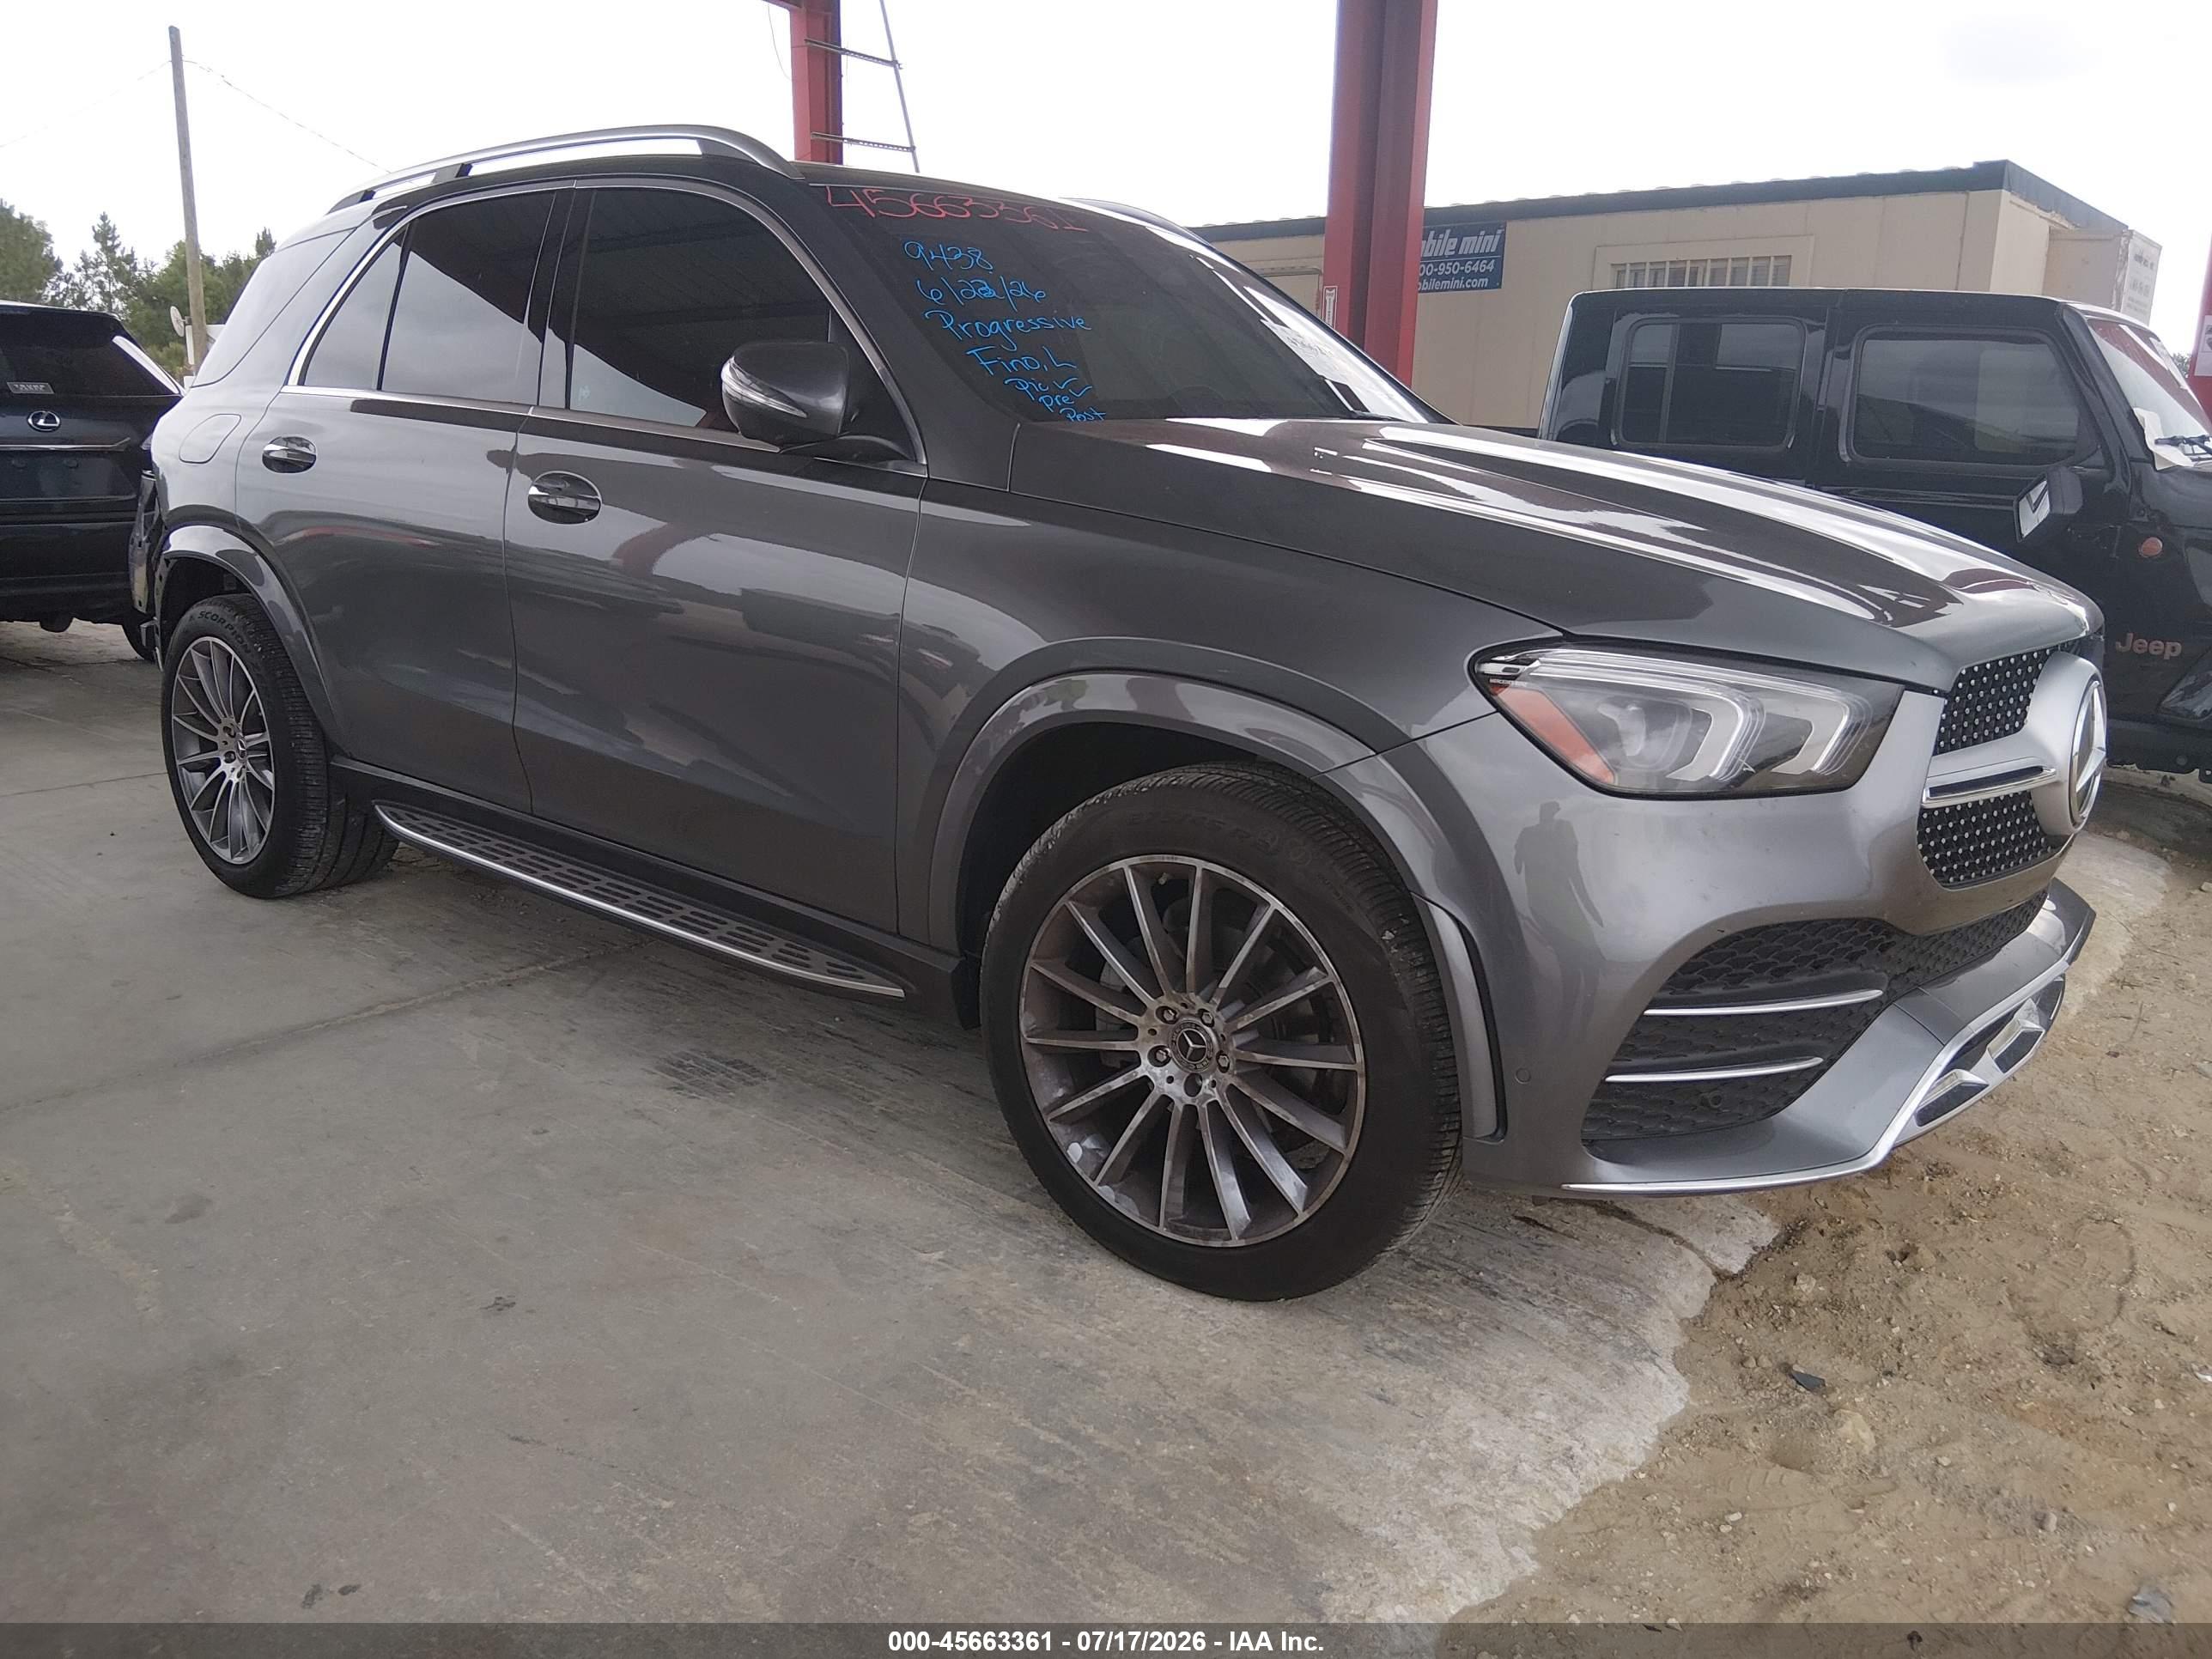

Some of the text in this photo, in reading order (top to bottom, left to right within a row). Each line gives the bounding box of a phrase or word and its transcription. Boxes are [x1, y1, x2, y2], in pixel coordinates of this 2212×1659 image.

[1420, 228, 1503, 258] bile mini
[1419, 258, 1495, 276] 00-950-6464
[1418, 276, 1489, 291] bilemini.com
[924, 310, 1092, 352] Progressive
[197, 610, 252, 653] SCORPION
[2115, 632, 2183, 660] Jeep
